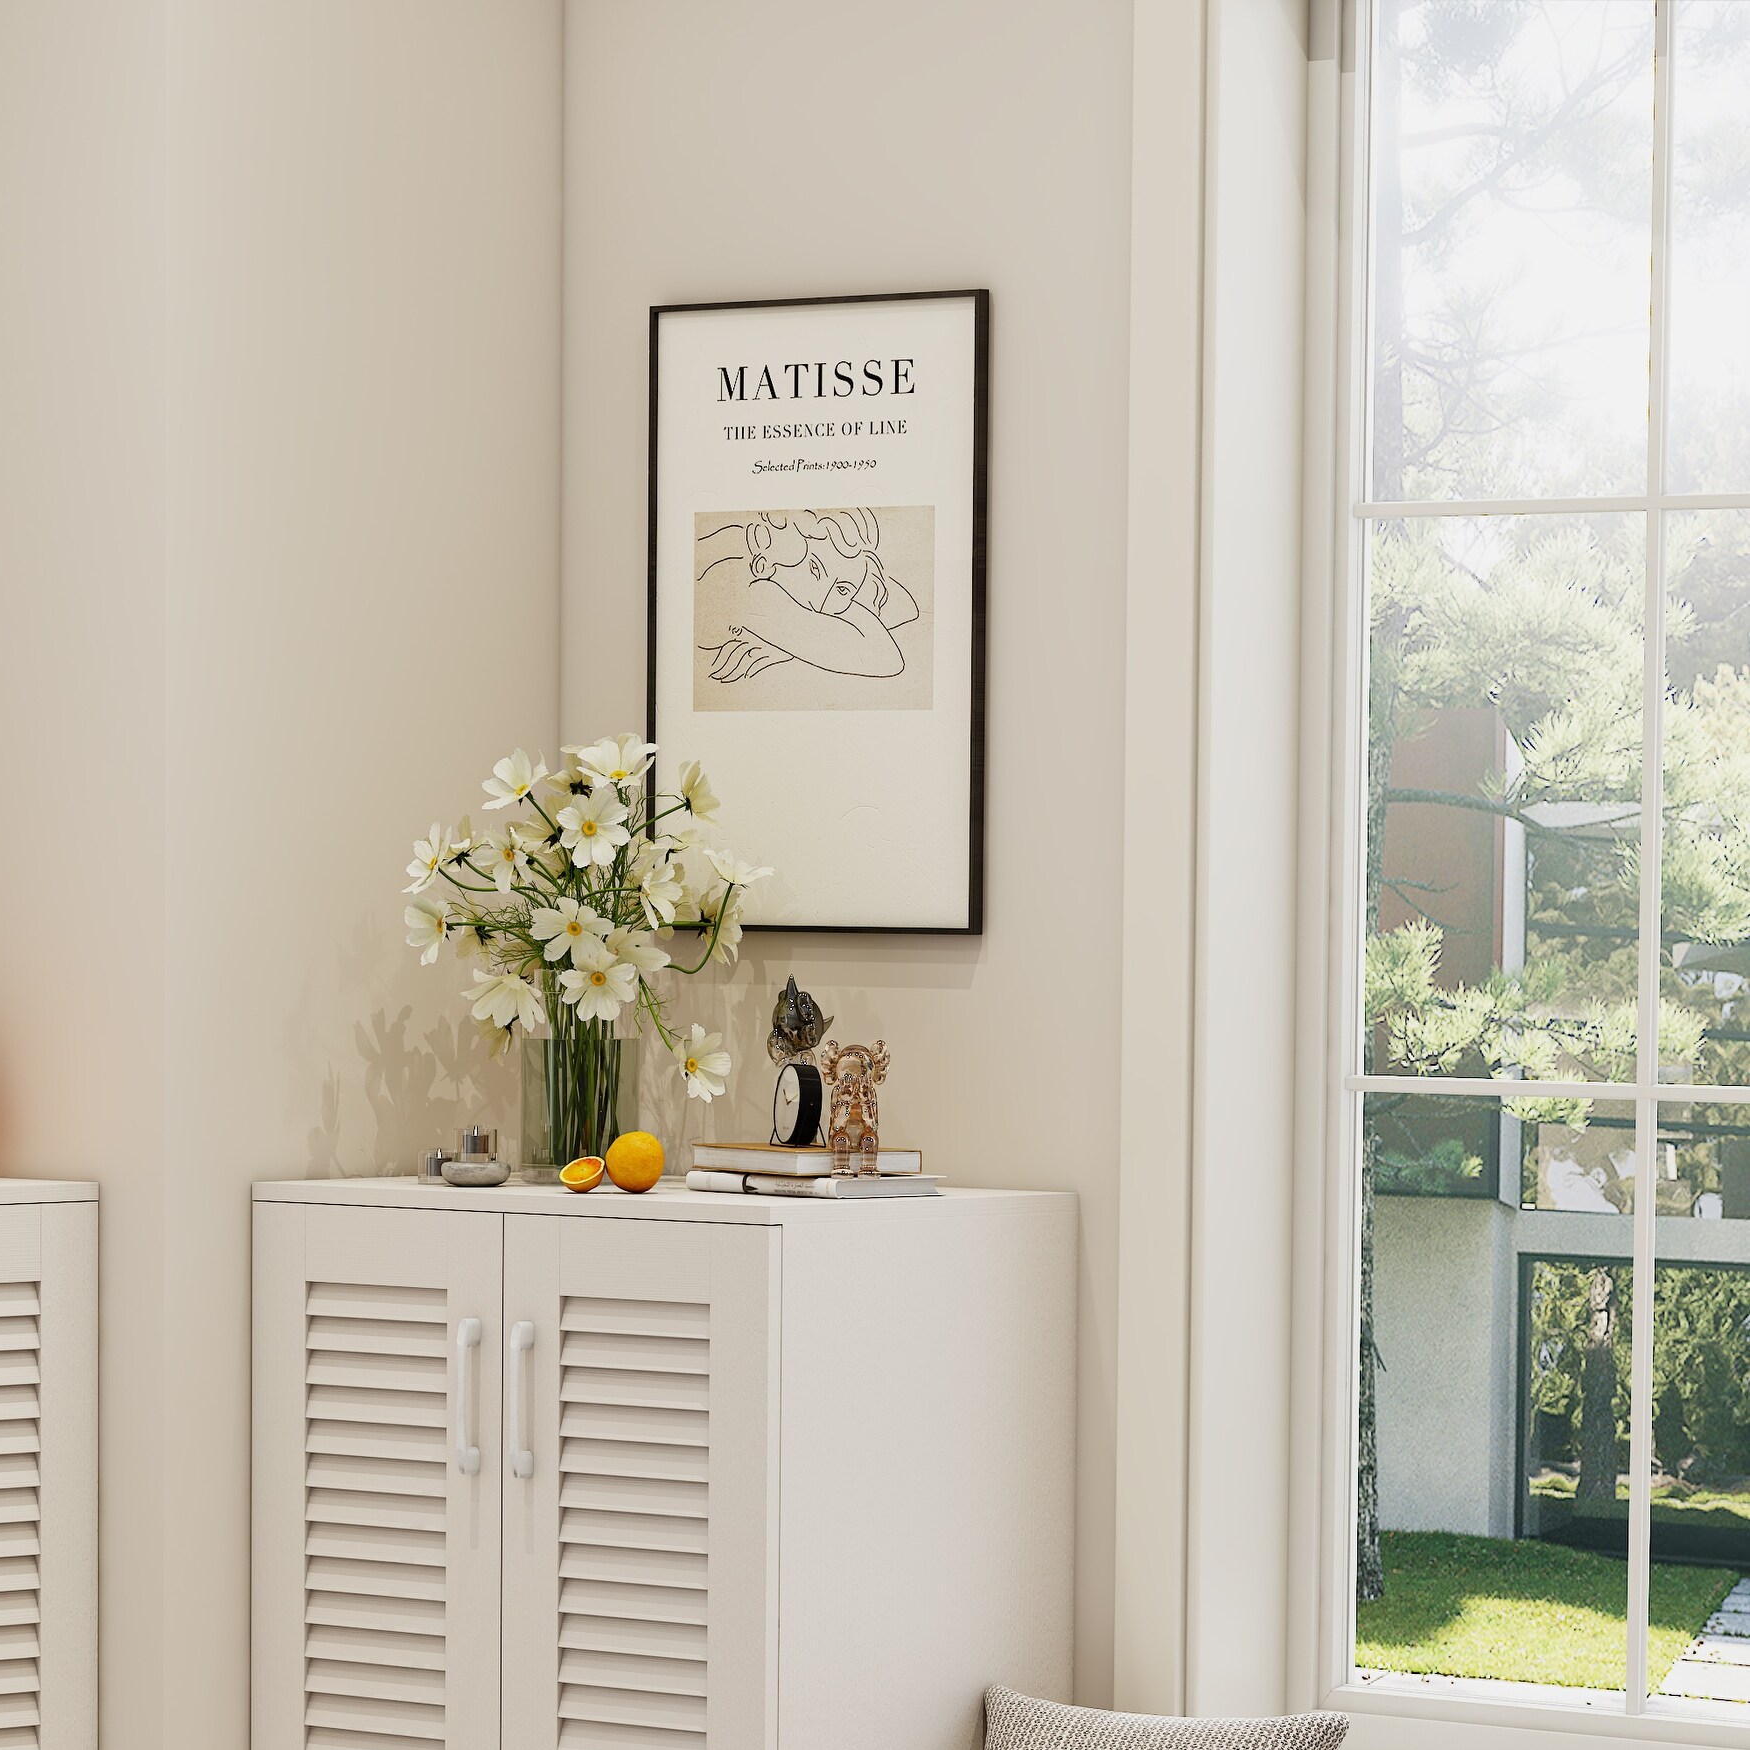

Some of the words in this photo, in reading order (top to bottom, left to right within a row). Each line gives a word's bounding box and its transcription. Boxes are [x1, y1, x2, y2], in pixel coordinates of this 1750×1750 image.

[716, 358, 916, 402] MATISSE
[723, 425, 757, 441] THE
[762, 422, 836, 440] ESSENCE
[841, 421, 864, 437] OF
[868, 419, 908, 436] LINE
[751, 460, 796, 475] Selected
